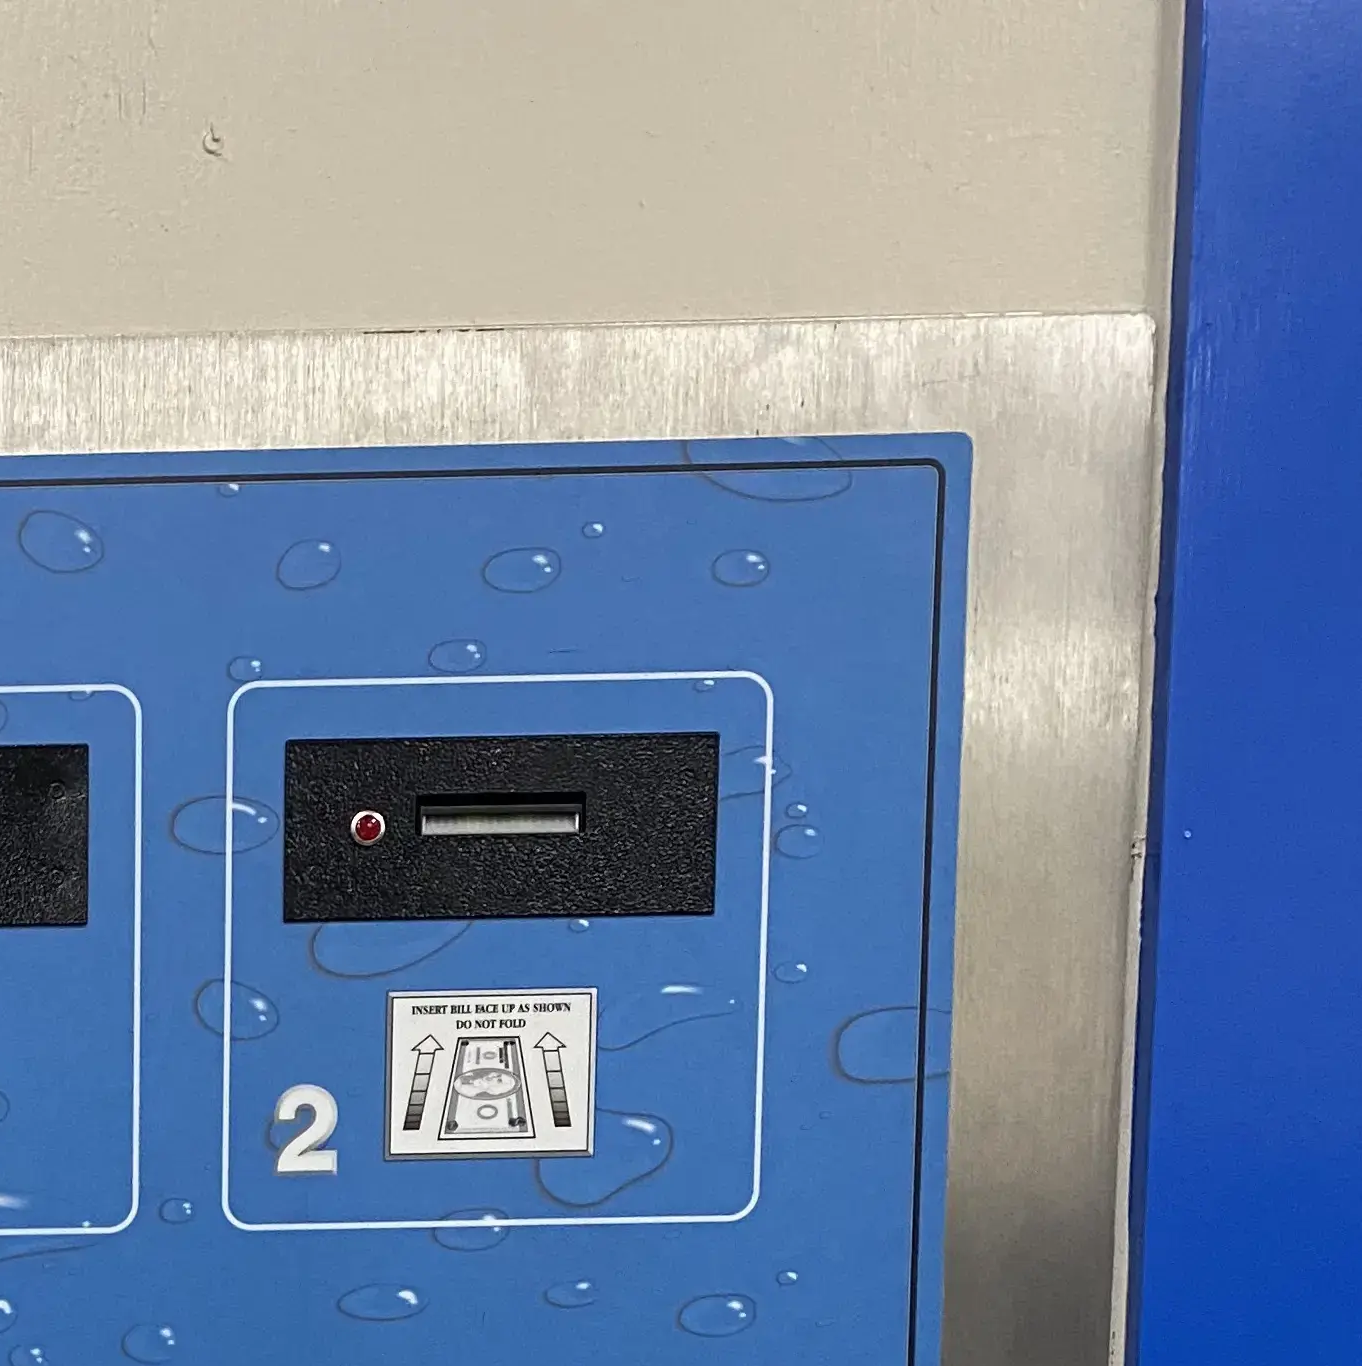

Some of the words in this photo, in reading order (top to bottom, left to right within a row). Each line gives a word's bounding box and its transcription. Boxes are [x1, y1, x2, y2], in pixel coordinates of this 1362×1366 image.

[412, 1005, 448, 1015] INSERT
[450, 1004, 472, 1014] BILL
[475, 1004, 498, 1014] FACE
[501, 1003, 516, 1014] UP
[517, 1003, 530, 1013] AS
[533, 1002, 571, 1013] SHOWN
[456, 1019, 472, 1029] DO
[474, 1019, 497, 1029] NOT
[498, 1018, 526, 1028] FOLD
[274, 1084, 338, 1177] 2
